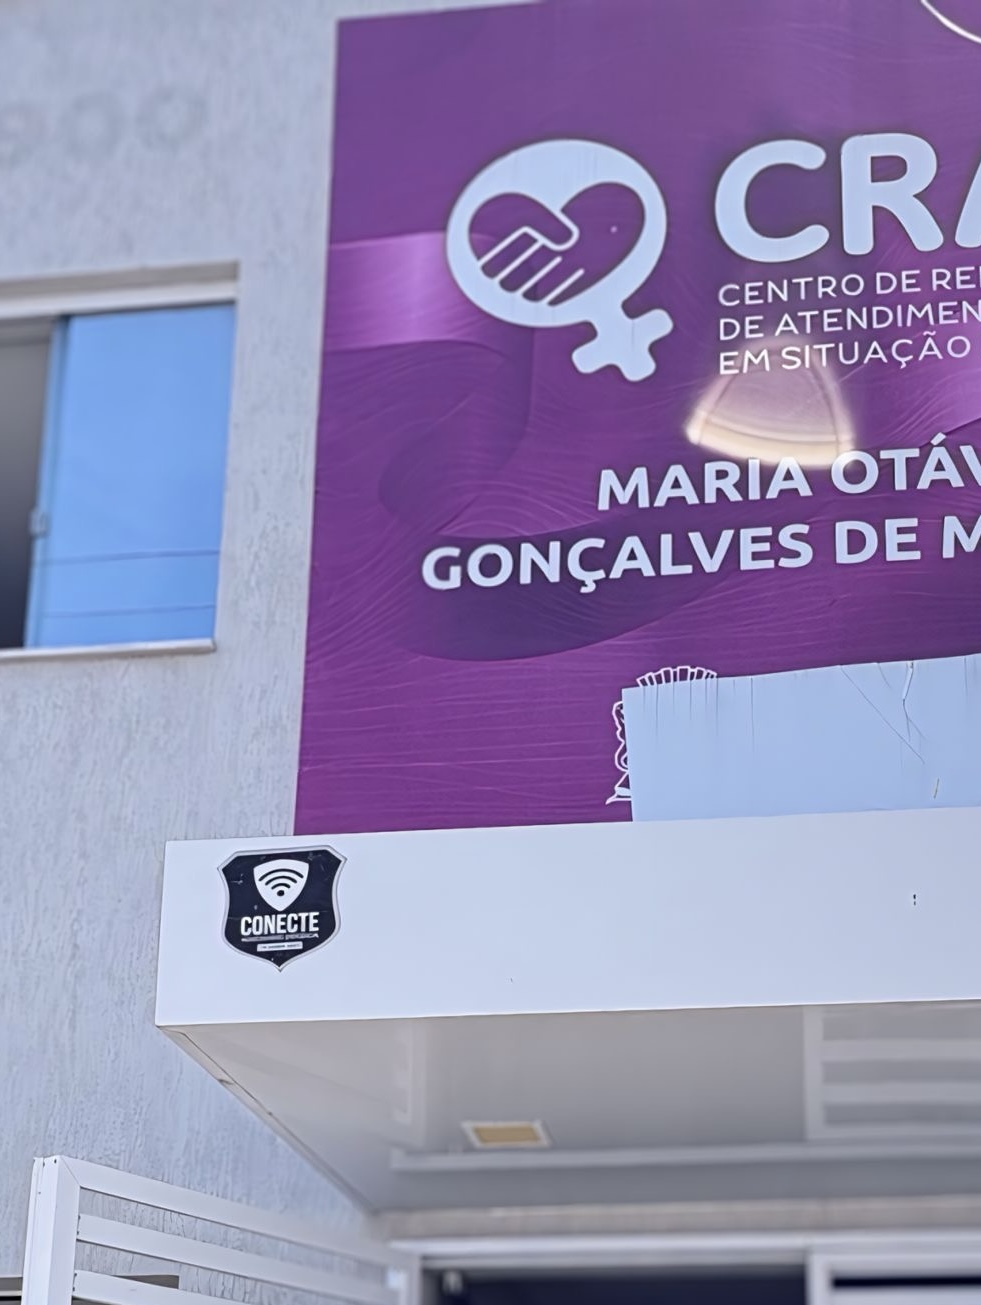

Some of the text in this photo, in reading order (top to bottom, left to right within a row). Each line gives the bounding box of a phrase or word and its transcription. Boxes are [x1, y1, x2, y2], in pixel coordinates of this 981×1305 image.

[718, 274, 865, 307] CENTRO
[875, 269, 922, 295] DE
[719, 316, 765, 342] DE
[719, 349, 770, 374] EM
[780, 331, 971, 369] SITUAÇÃO
[597, 456, 812, 511] MARIA
[422, 523, 814, 594] GONÇALVES
[835, 517, 922, 564] DE
[240, 911, 320, 936] CONECTE
